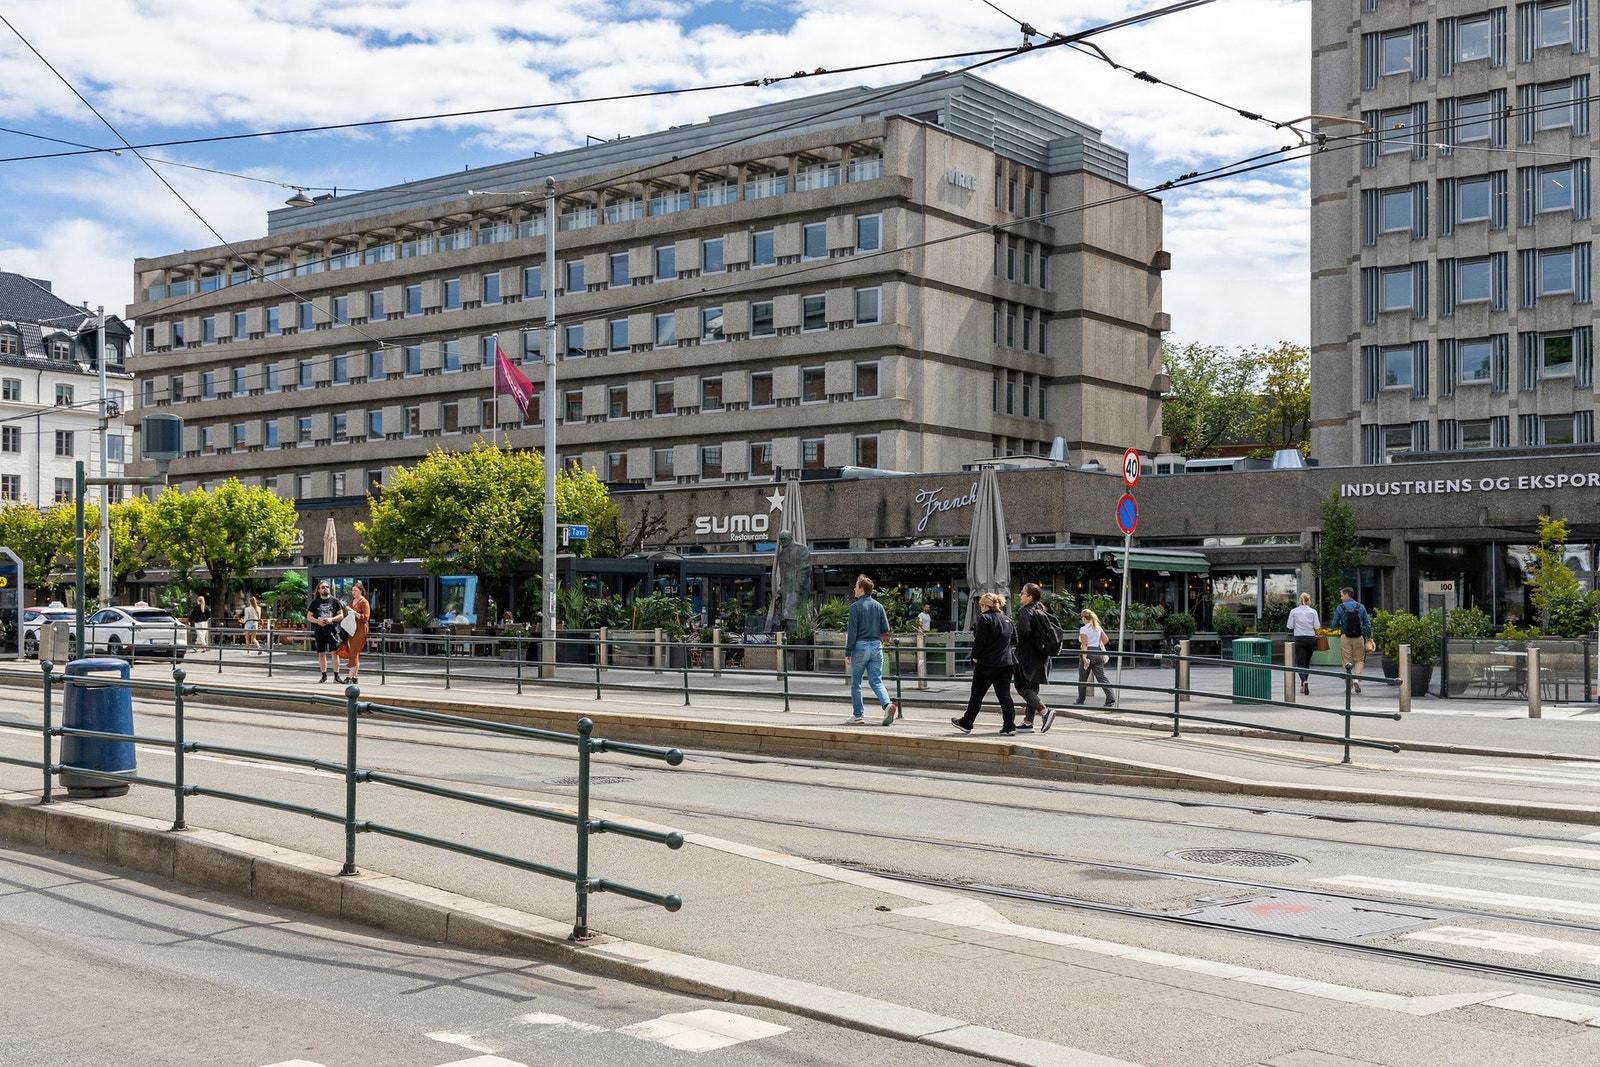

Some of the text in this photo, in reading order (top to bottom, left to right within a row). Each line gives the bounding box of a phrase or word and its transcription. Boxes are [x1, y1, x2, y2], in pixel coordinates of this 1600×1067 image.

[1126, 458, 1137, 478] 40
[1341, 473, 1600, 497] INDUSTRIENS OG EKSPOR
[572, 527, 586, 536] Taxi
[695, 514, 769, 535] SUMO
[730, 532, 769, 541] Restaurants
[1440, 583, 1453, 591] 100
